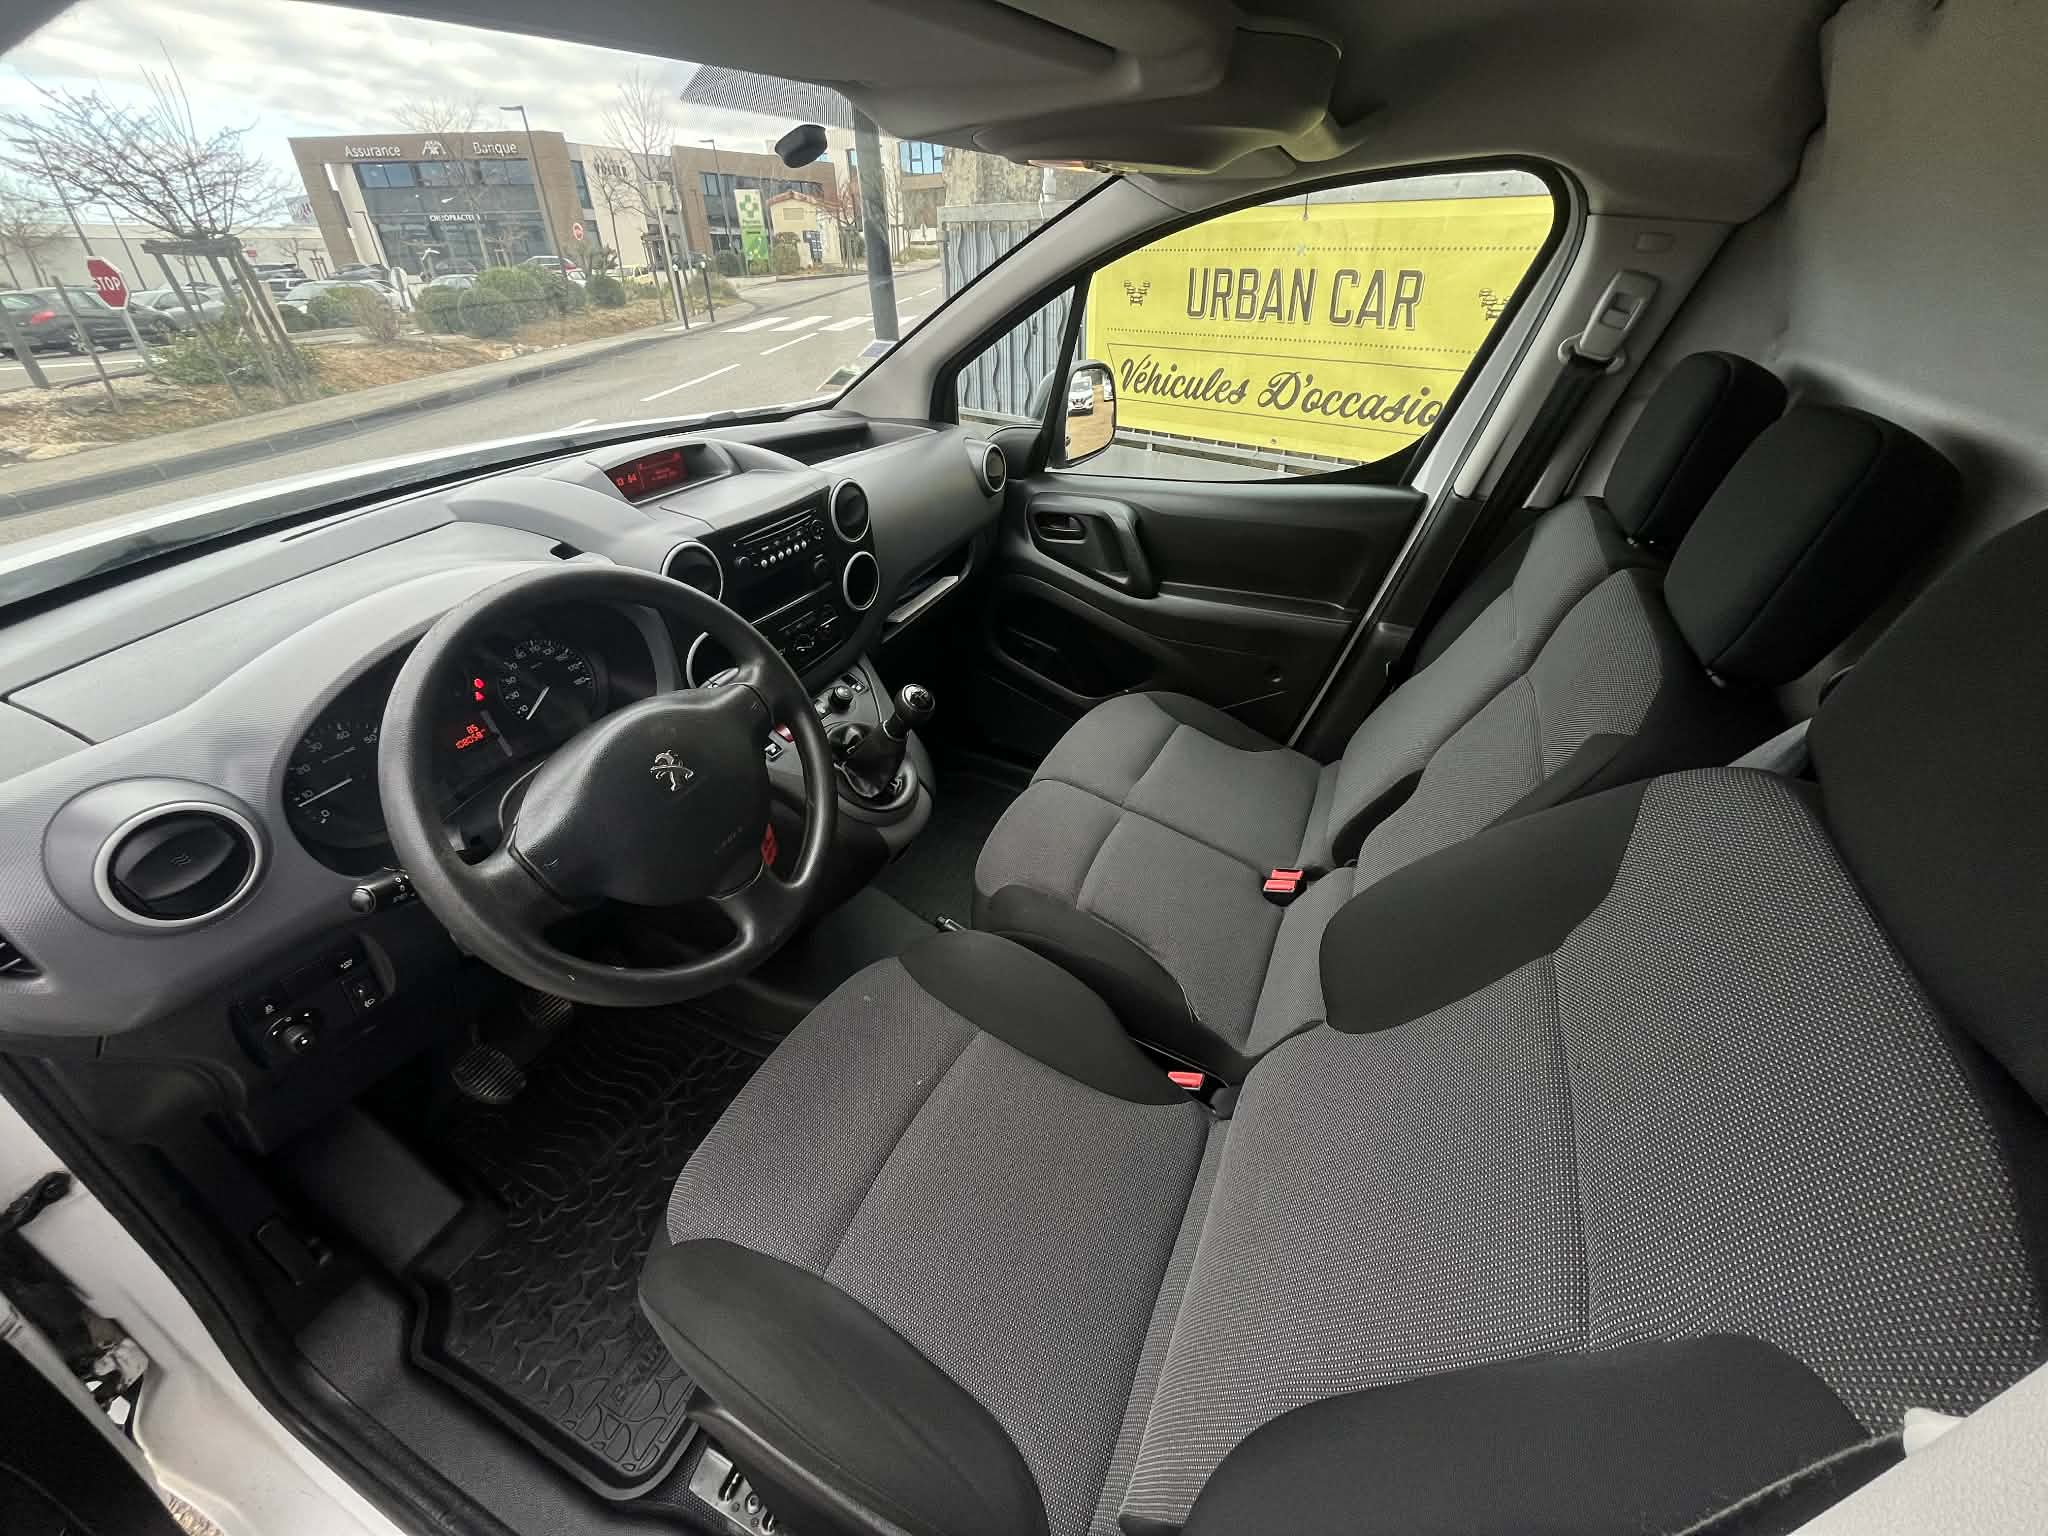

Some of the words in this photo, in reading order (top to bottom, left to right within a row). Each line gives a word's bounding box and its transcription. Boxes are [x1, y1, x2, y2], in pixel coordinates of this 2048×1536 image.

[345, 145, 401, 158] Assurance
[473, 141, 519, 157] Banque
[95, 276, 121, 291] STOP
[1186, 266, 1318, 325] URBAN
[1328, 268, 1426, 330] CAR
[1120, 354, 1251, 402] Véhicules
